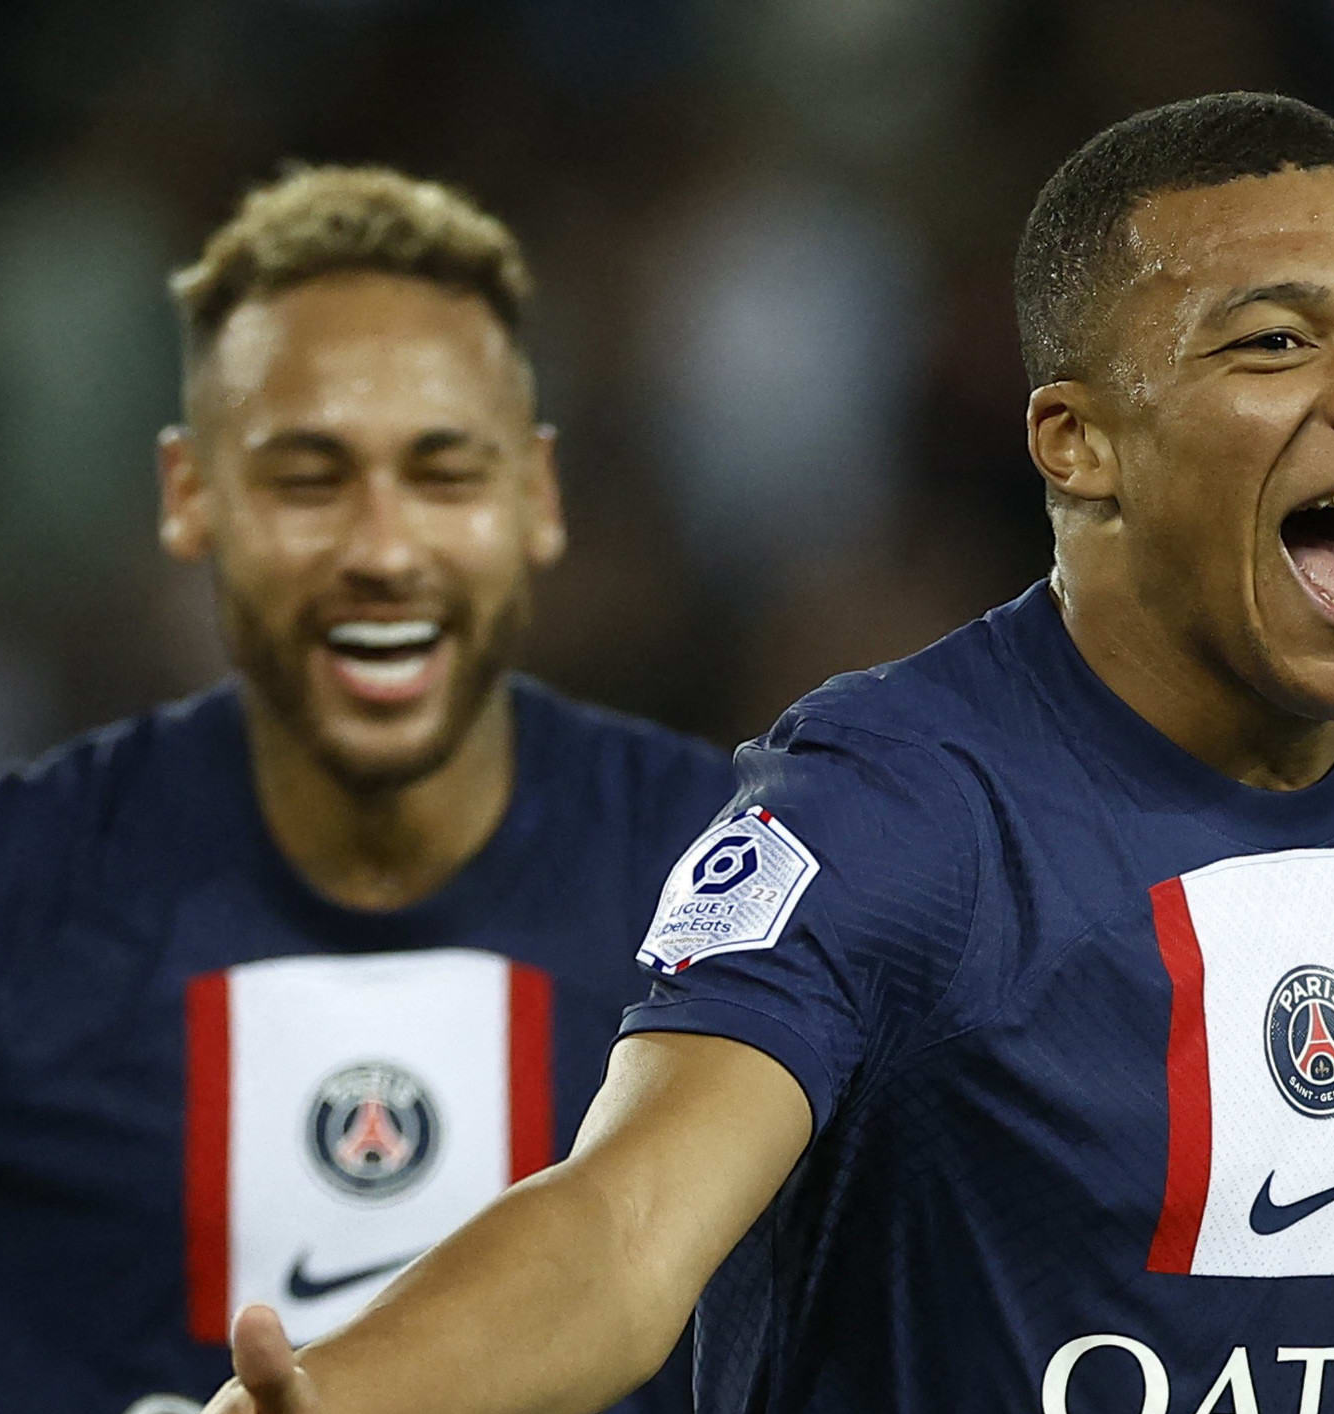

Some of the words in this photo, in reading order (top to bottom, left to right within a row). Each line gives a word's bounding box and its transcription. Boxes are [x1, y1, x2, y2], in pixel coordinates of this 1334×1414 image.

[670, 902, 722, 917] LIGUE
[726, 904, 735, 915] 1
[690, 917, 732, 933] Eats
